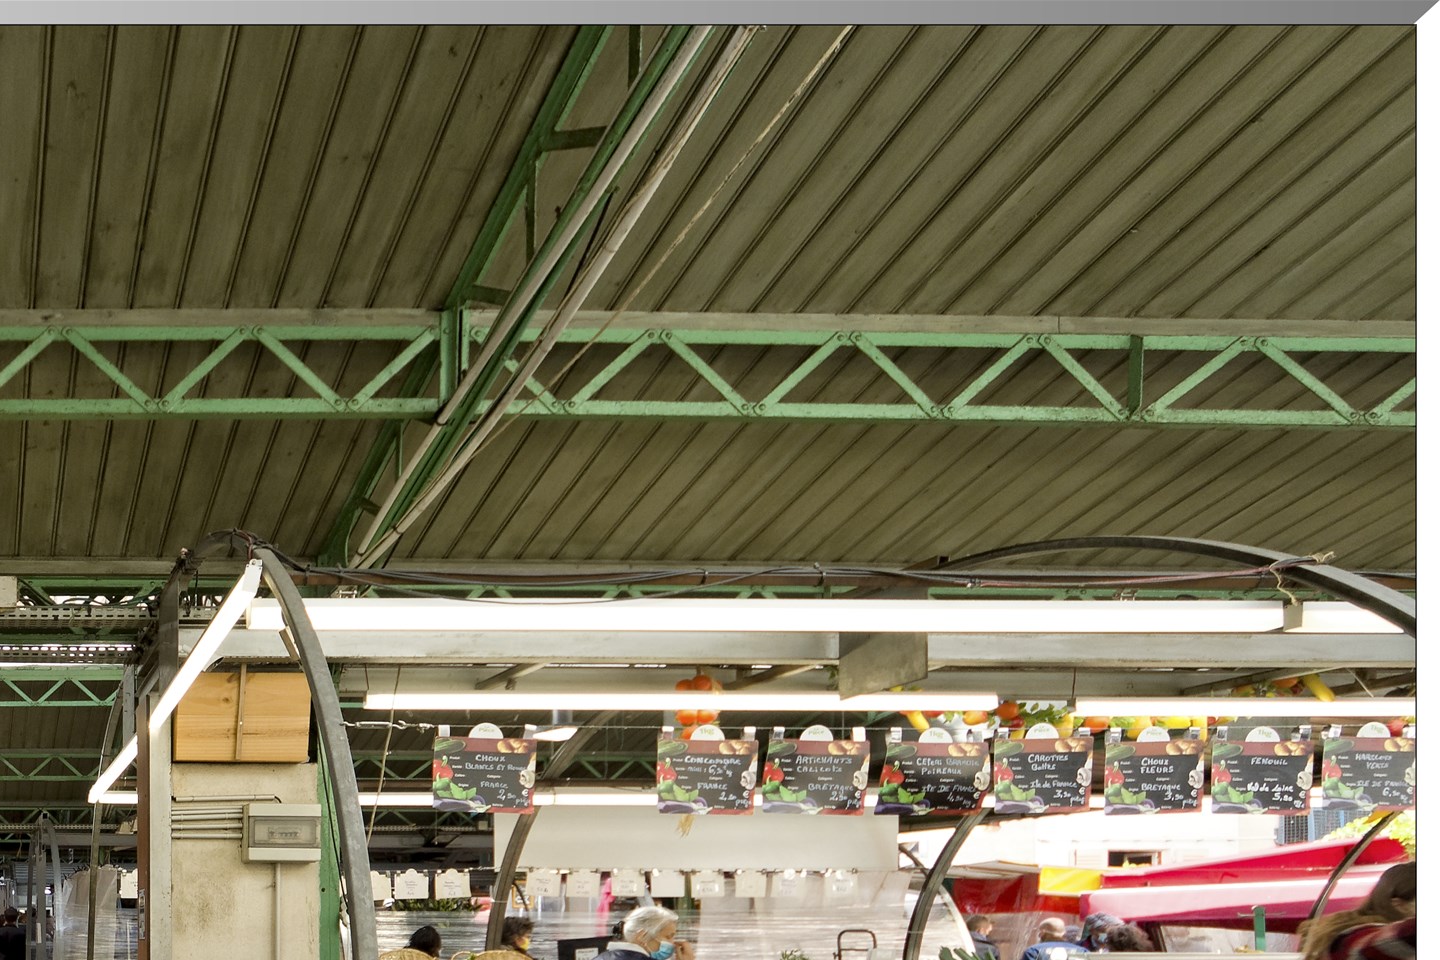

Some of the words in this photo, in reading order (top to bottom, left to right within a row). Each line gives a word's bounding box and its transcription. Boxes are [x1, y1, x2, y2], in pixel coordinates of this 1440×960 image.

[475, 754, 506, 762] CHOUX
[1141, 757, 1169, 766] CHOUX
[1140, 765, 1174, 774] FLEURS
